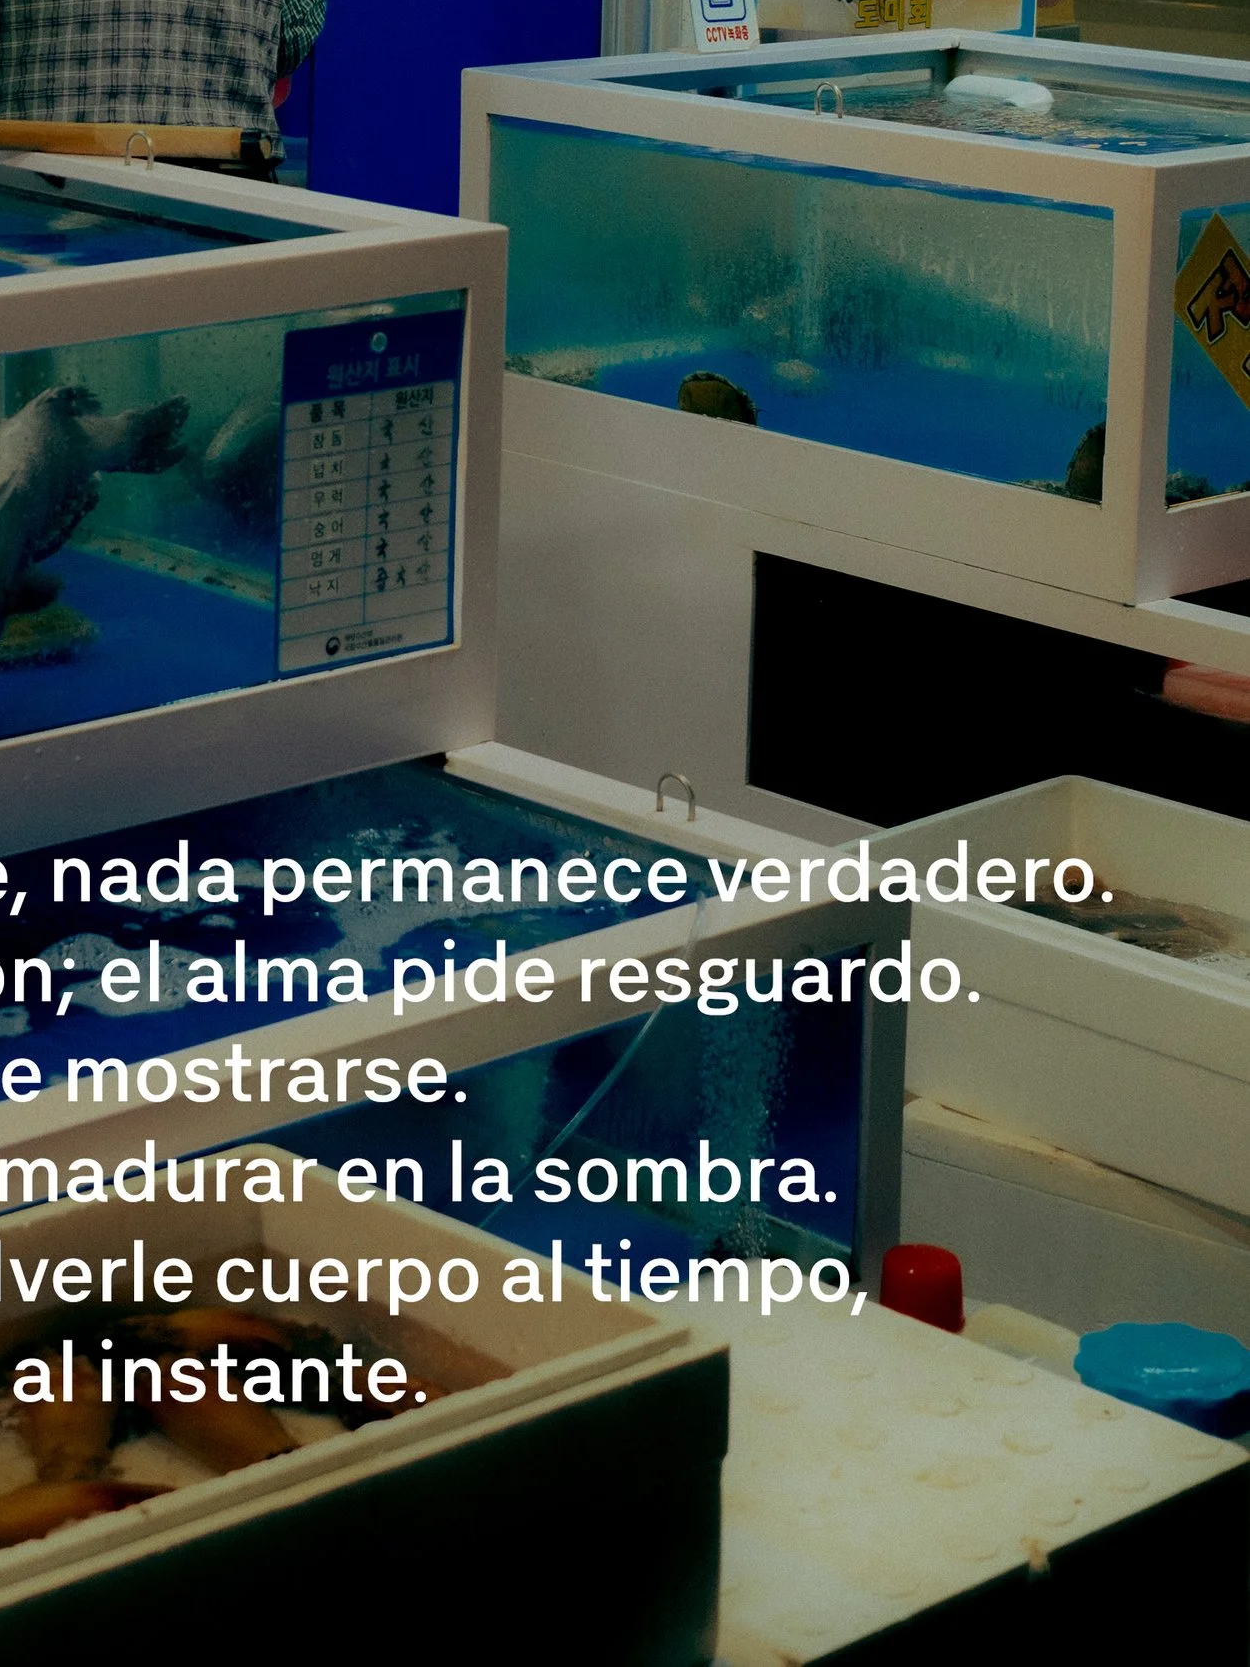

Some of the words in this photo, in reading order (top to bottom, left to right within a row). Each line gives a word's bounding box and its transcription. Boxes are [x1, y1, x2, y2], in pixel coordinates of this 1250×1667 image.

[327, 358, 380, 389] 원산지
[384, 353, 421, 378] 표시
[395, 387, 434, 410] 원산지
